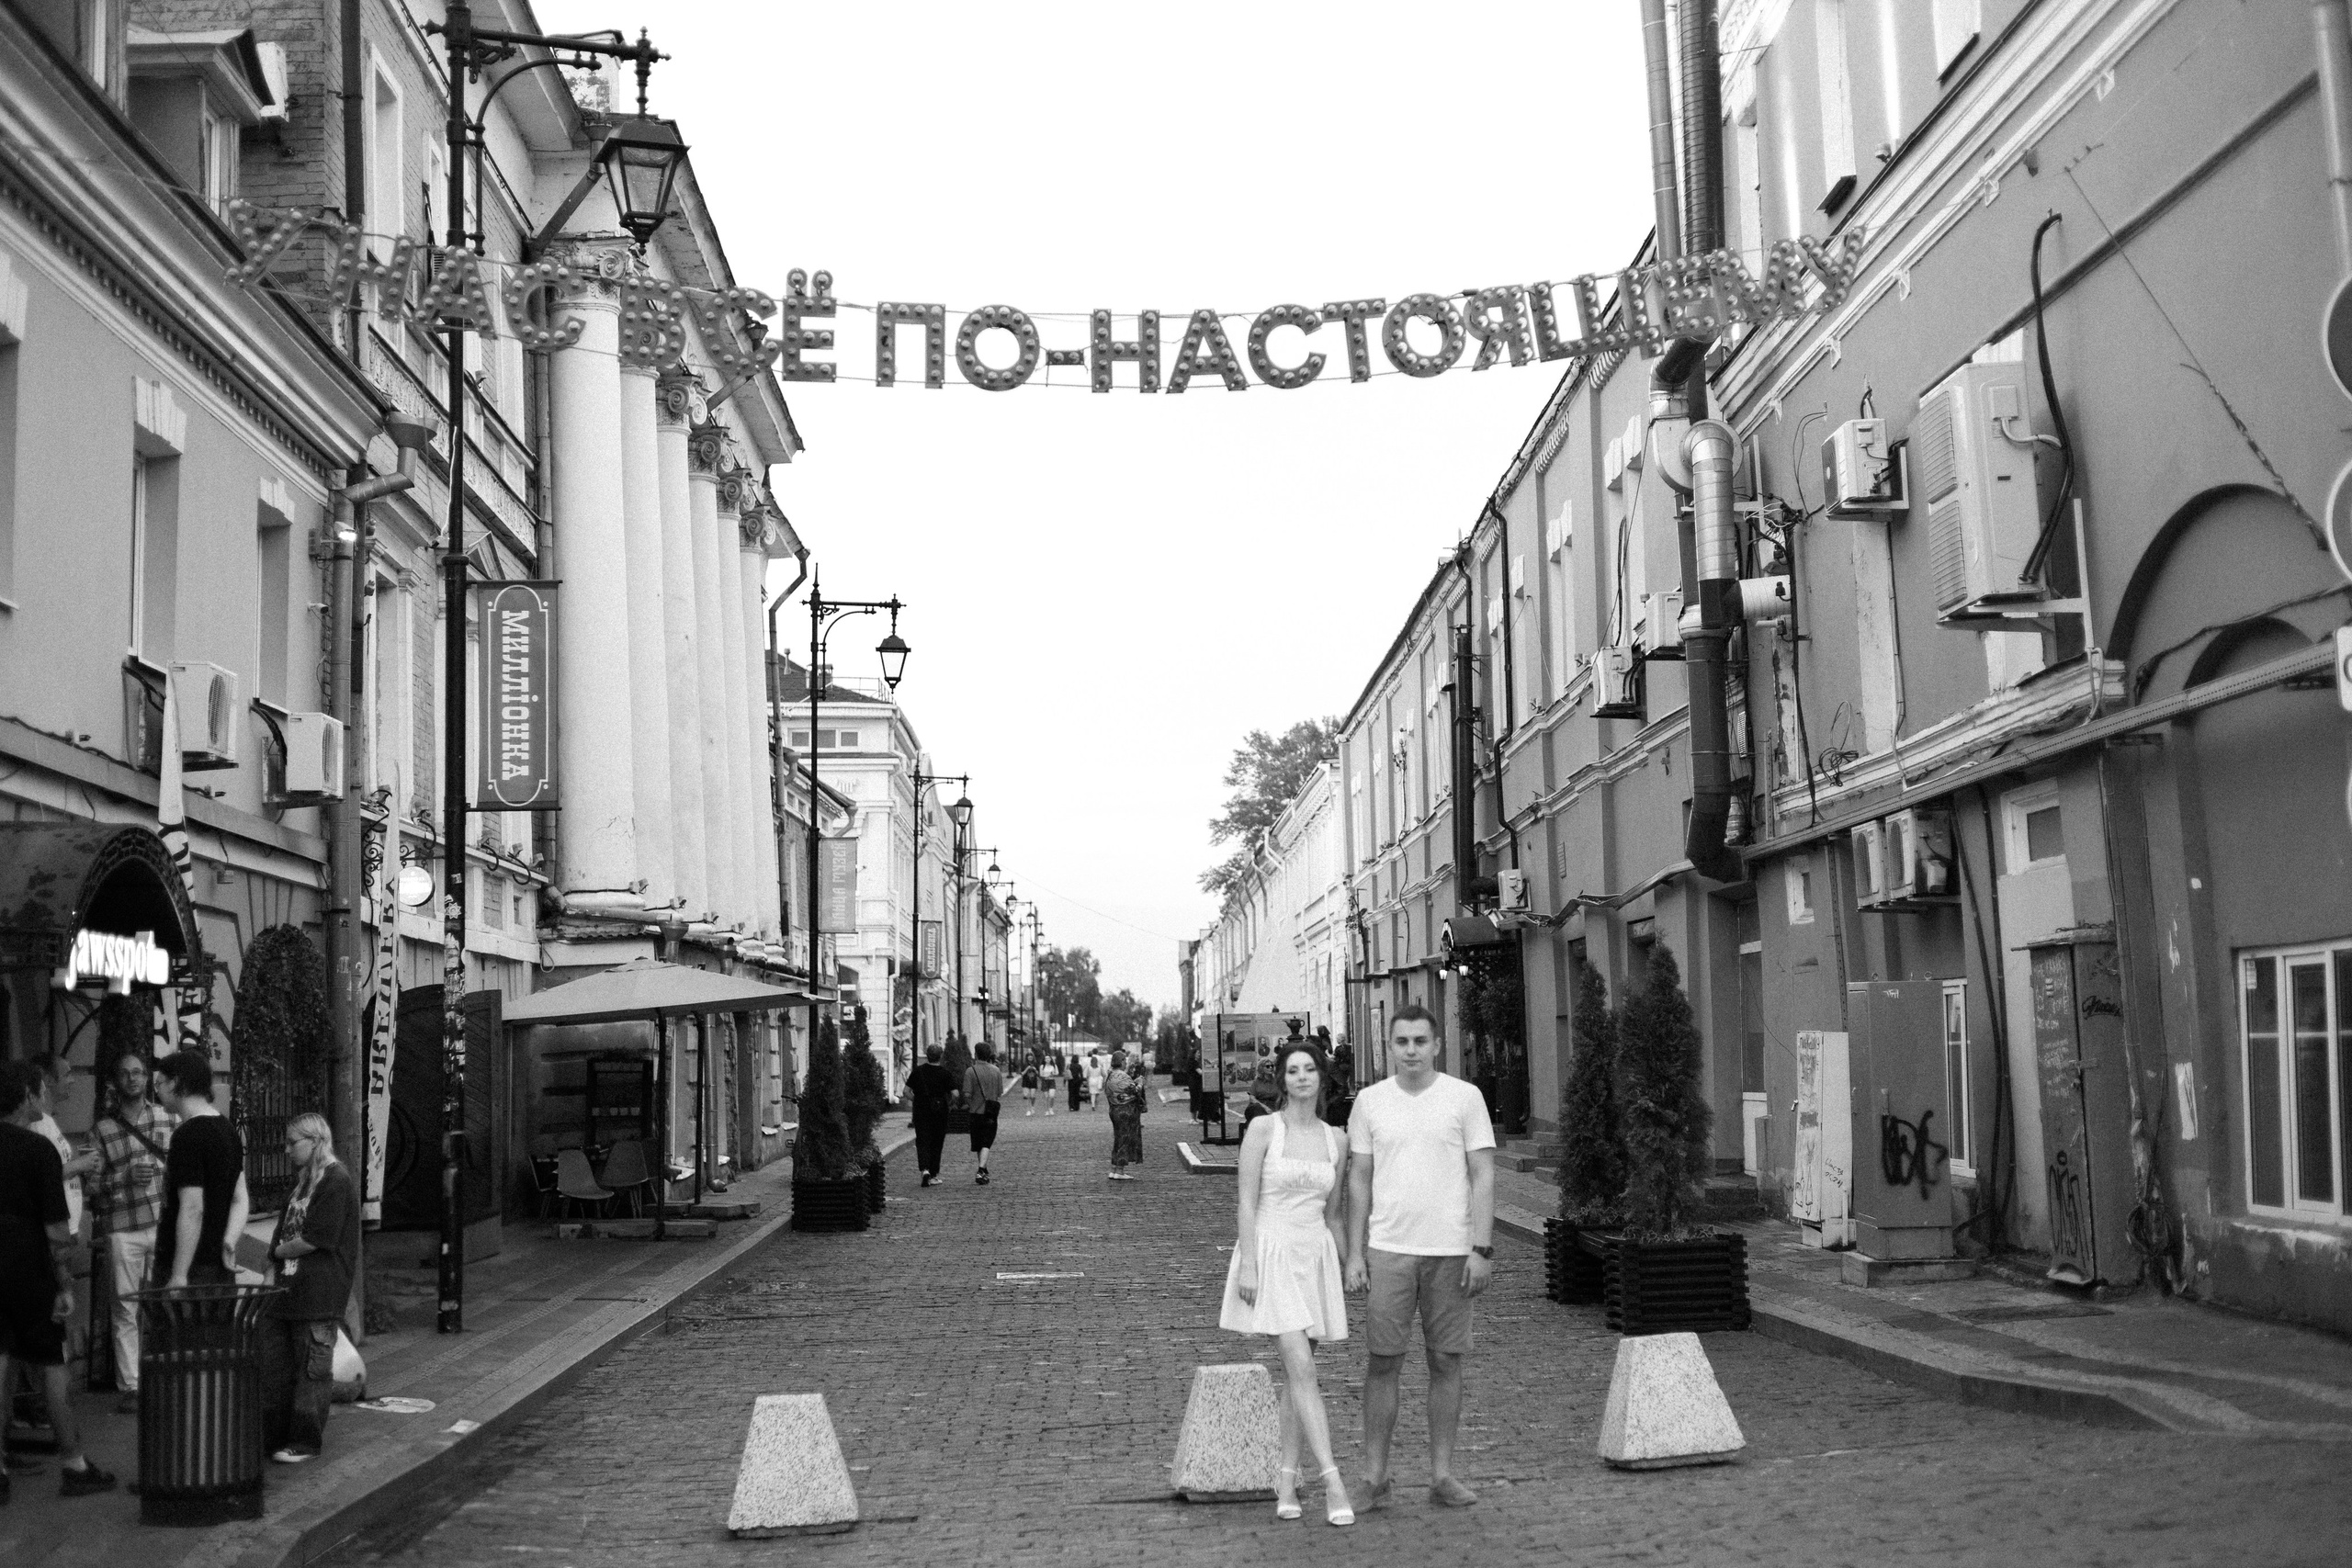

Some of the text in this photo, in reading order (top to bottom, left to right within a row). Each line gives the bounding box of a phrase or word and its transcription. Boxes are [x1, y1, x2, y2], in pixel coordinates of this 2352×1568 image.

[224, 197, 1867, 394] У НАС ВСЁ ПО-НАСТОЯЩЕМУ
